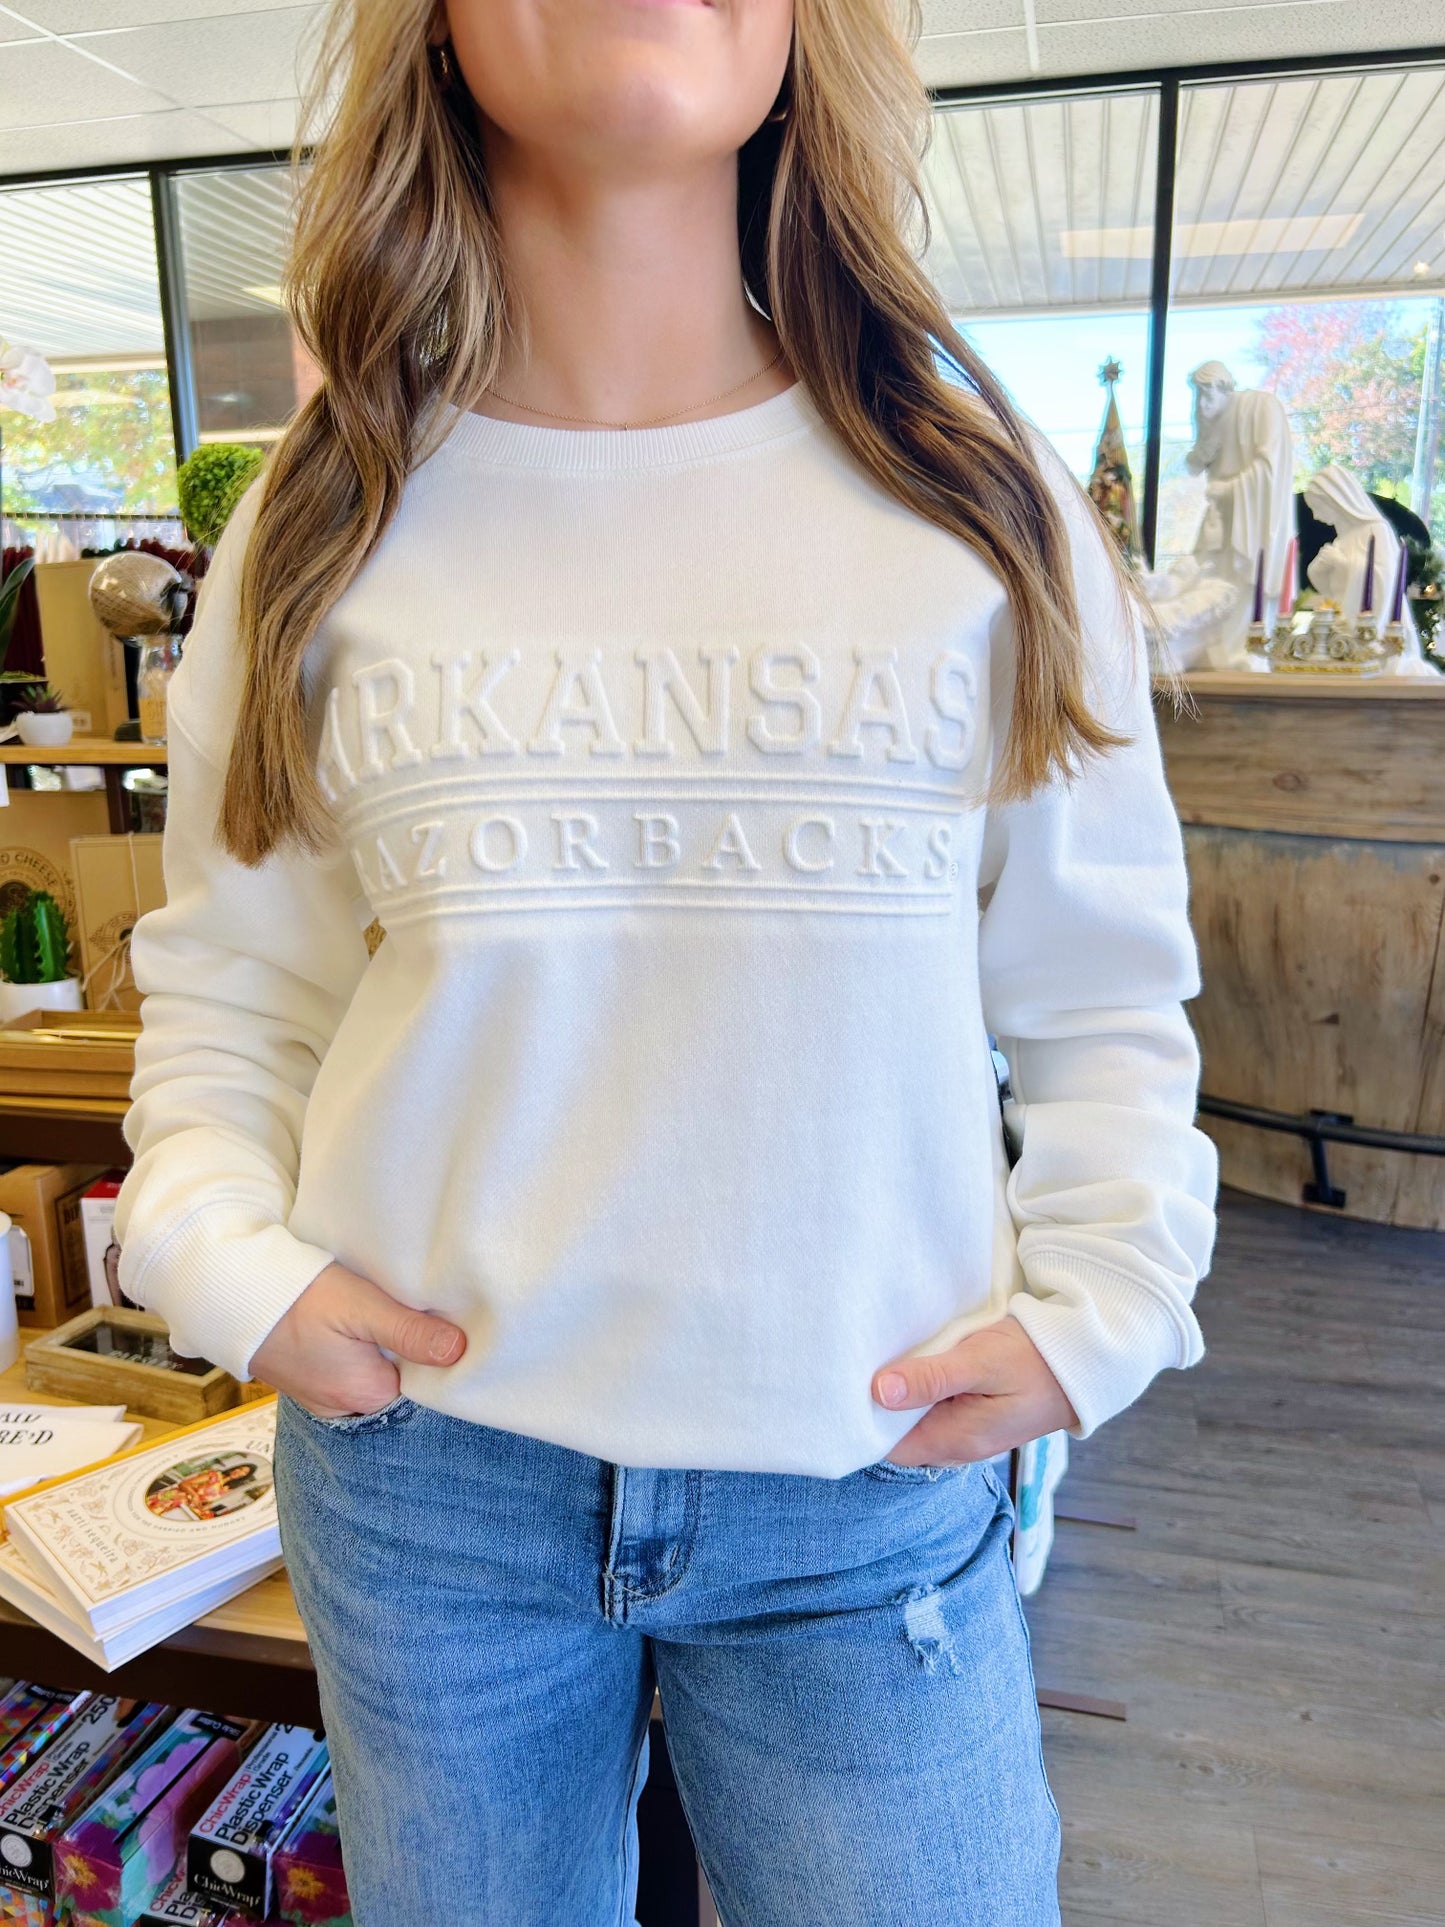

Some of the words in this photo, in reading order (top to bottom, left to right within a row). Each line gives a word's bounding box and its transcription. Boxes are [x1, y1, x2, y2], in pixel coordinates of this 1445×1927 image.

[352, 811, 954, 896] AZORBACKS
[82, 1695, 117, 1725] 250
[4, 1778, 57, 1826] Plastic
[47, 1741, 90, 1778] Wrap
[199, 1772, 252, 1834] ChicWrap
[214, 1786, 262, 1840] Plastic
[254, 1752, 289, 1789] Wrap
[230, 1771, 293, 1846] Dispenser
[194, 1873, 261, 1908] ChicWrap
